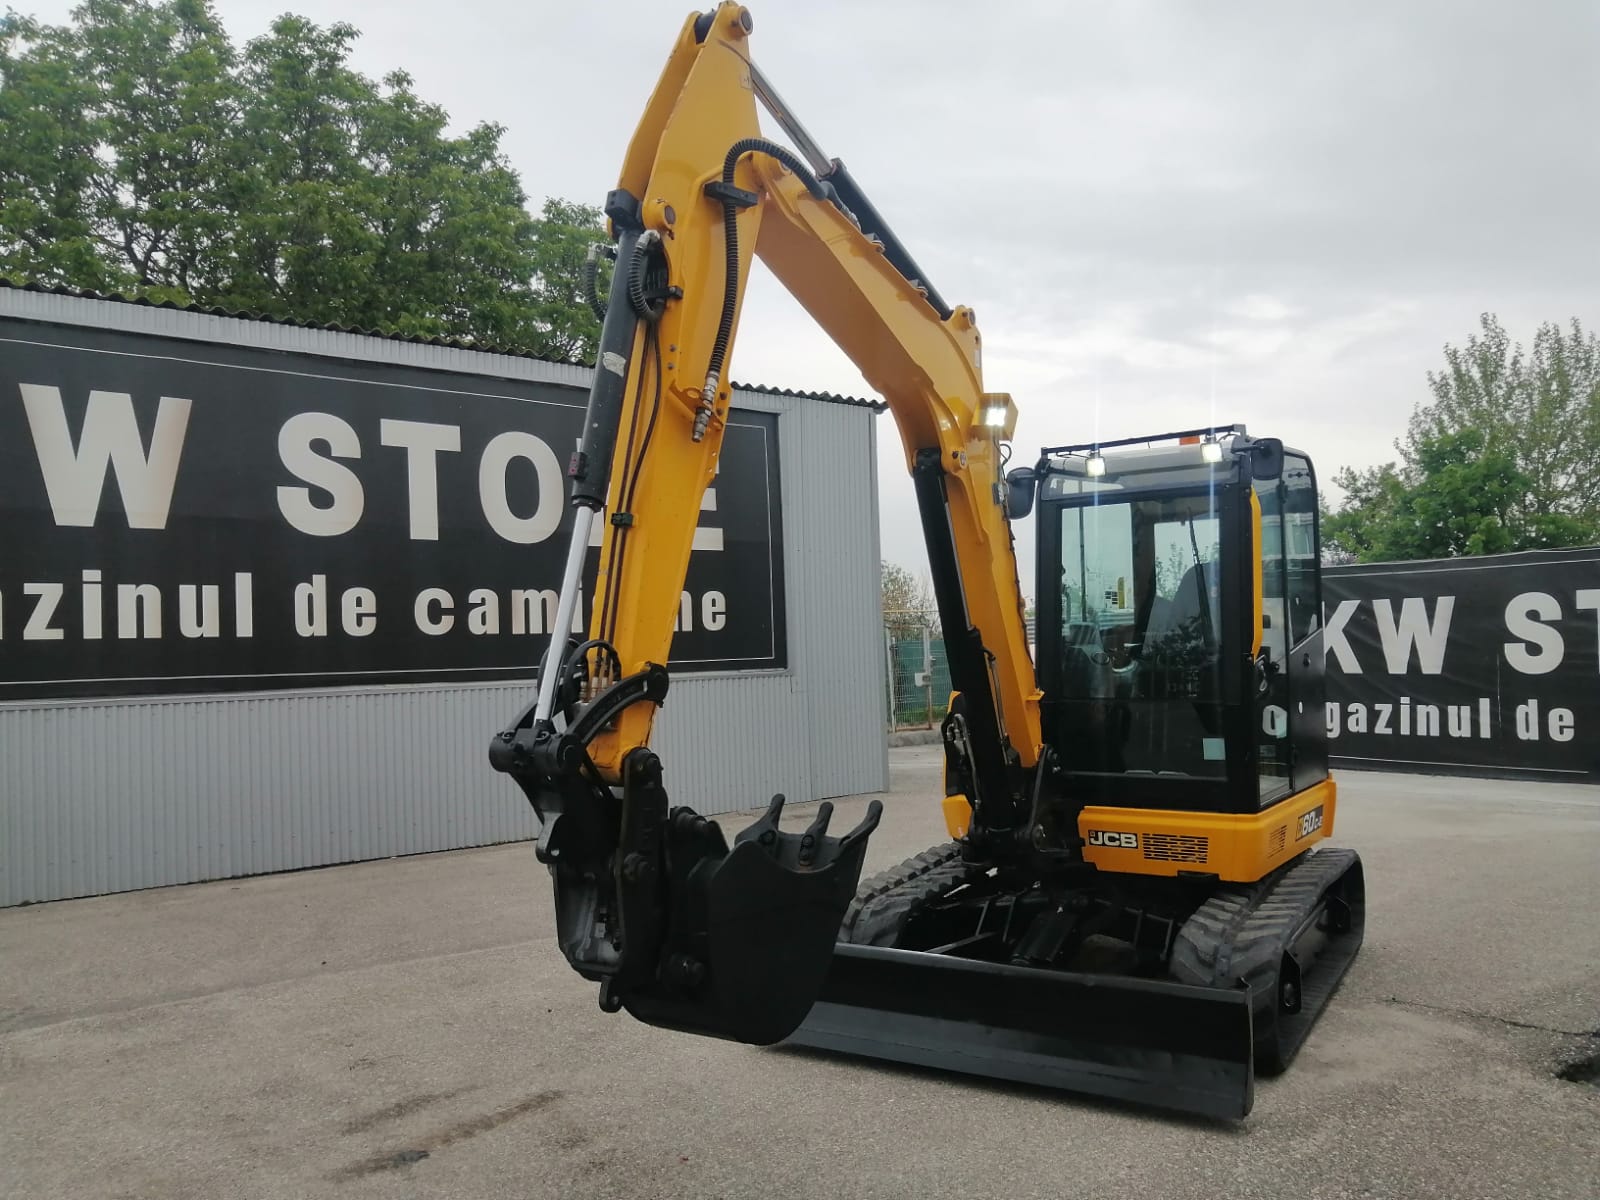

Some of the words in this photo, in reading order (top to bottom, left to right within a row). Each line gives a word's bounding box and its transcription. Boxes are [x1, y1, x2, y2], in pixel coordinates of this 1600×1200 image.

[19, 383, 193, 530] W
[277, 411, 724, 552] STO
[0, 569, 253, 640] zinul
[295, 574, 377, 638] de
[414, 579, 728, 637] camine
[1516, 698, 1576, 742] de
[1090, 831, 1138, 848] JCB
